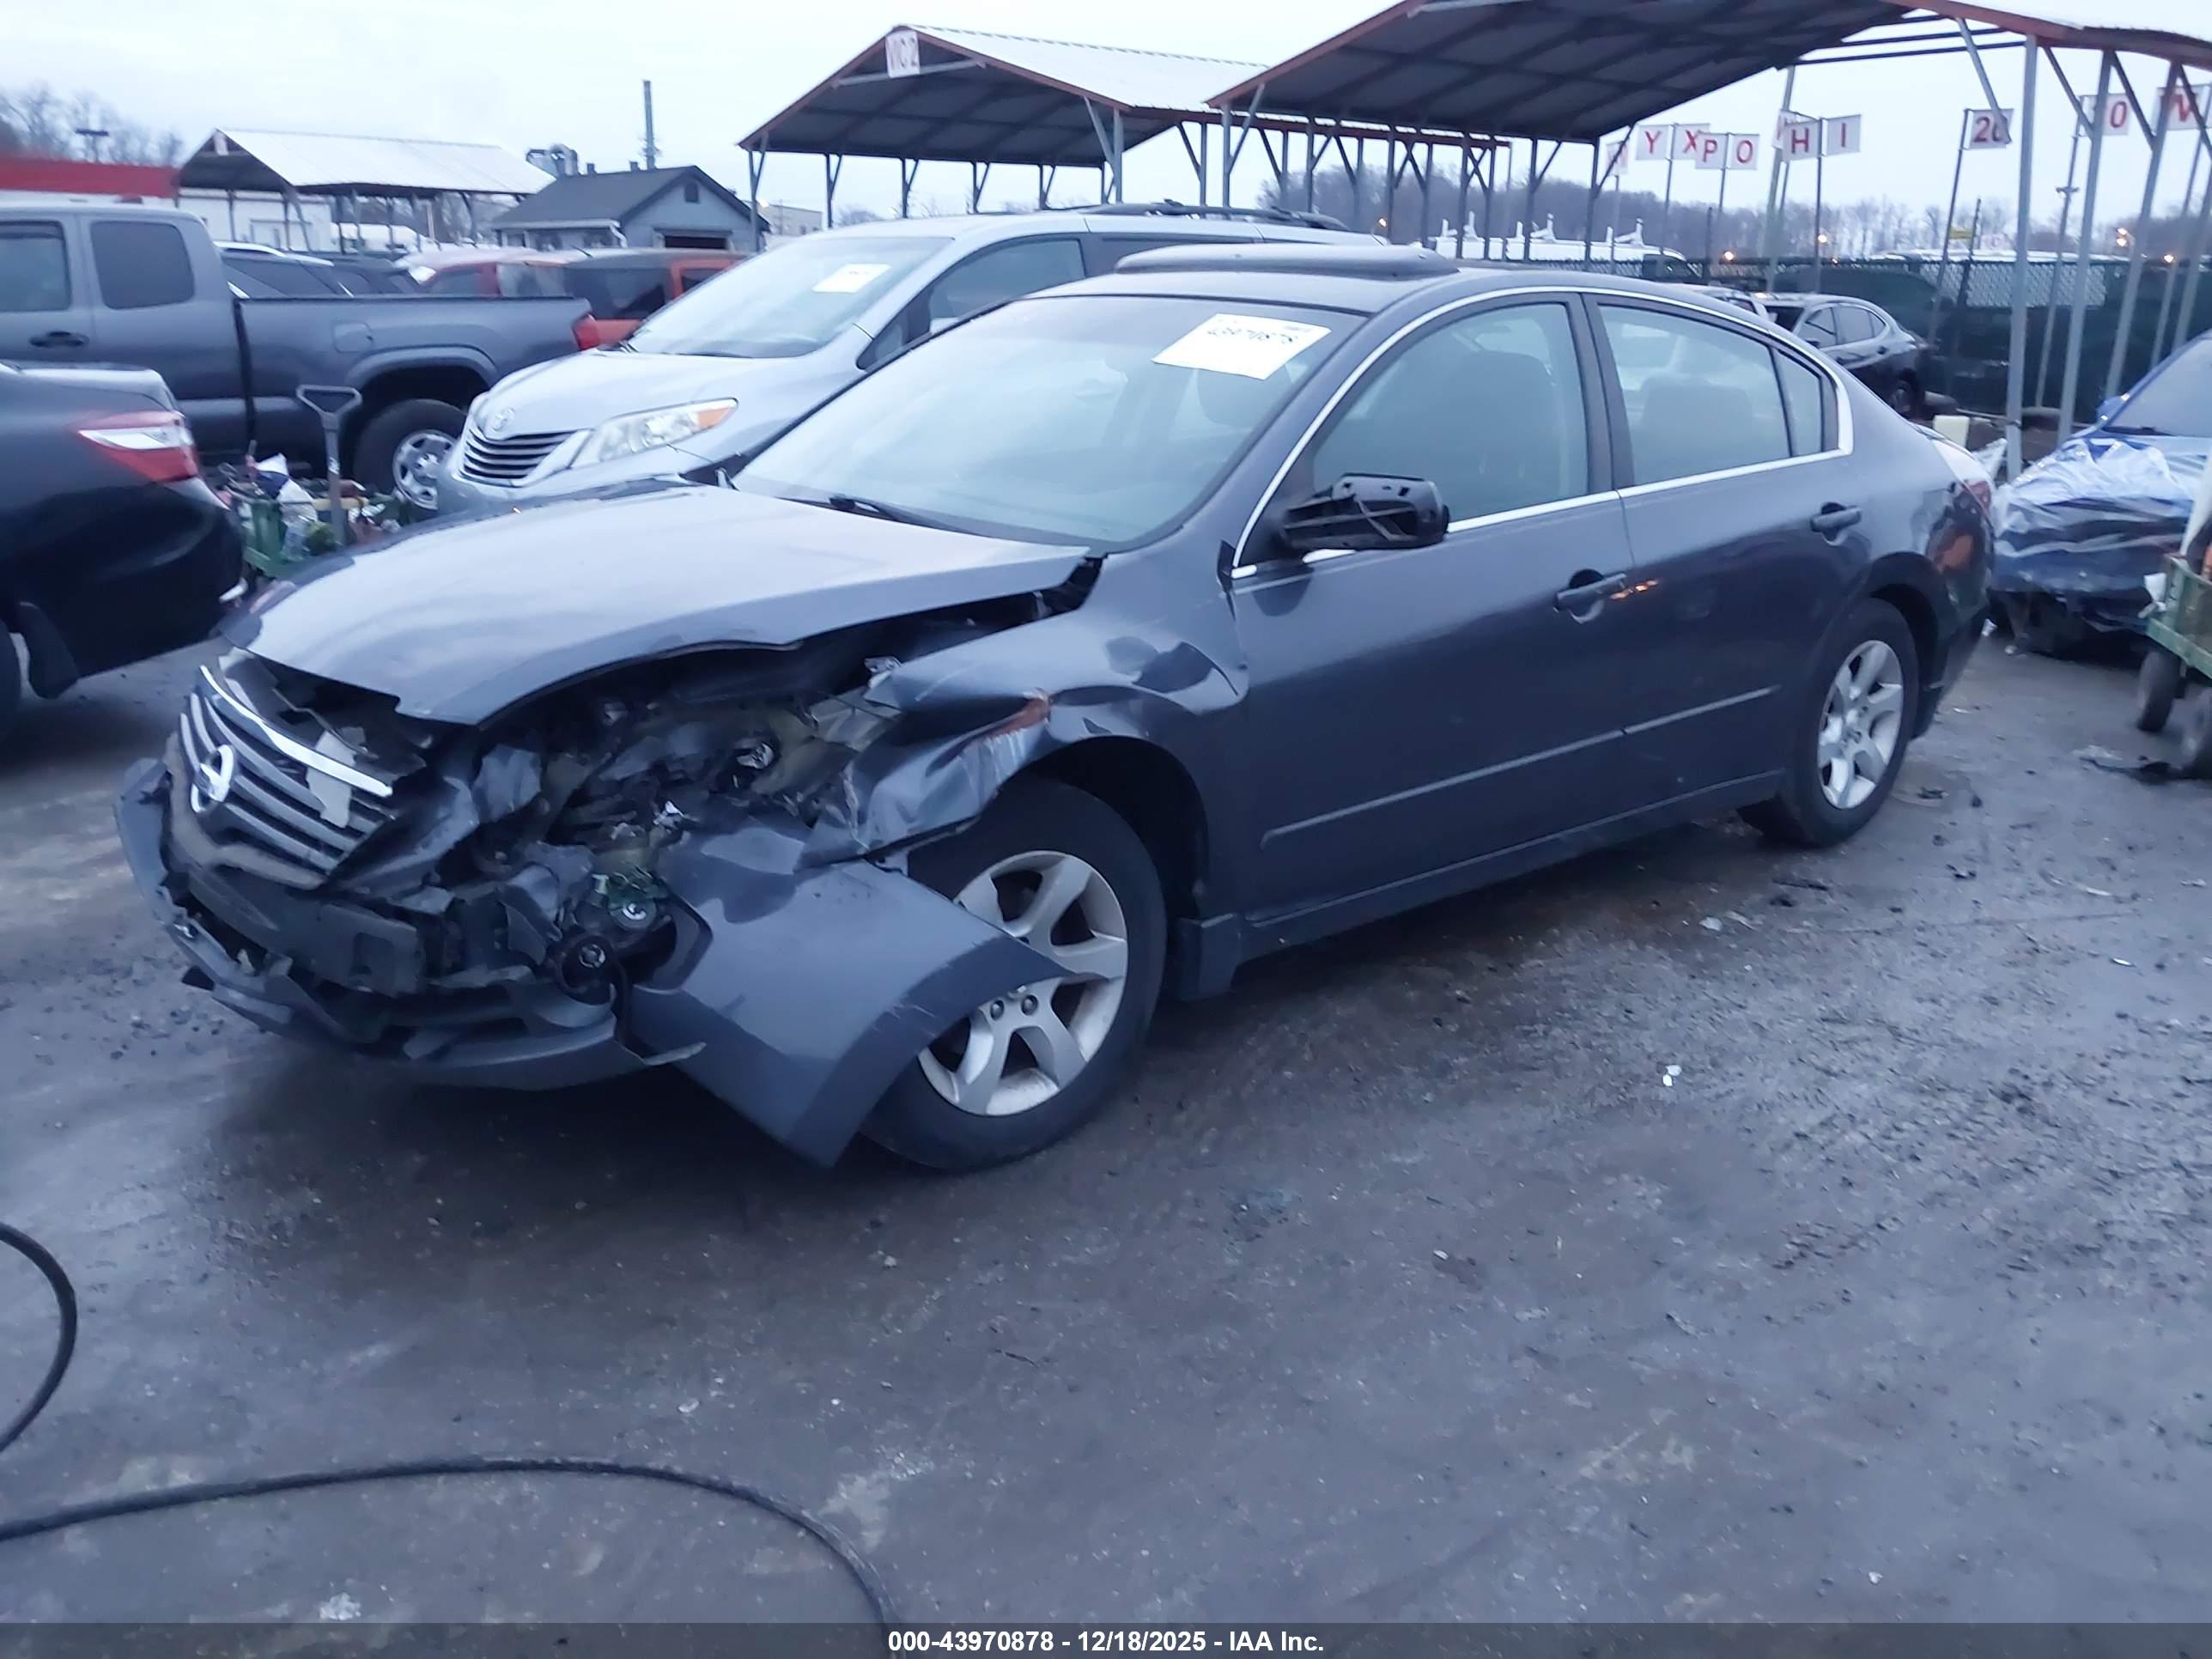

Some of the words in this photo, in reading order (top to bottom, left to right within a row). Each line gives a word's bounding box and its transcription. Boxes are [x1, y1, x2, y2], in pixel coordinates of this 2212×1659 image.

[1644, 130, 1661, 154] Y
[1683, 130, 1698, 154] X
[1703, 138, 1717, 162] P
[1790, 128, 1809, 155] H
